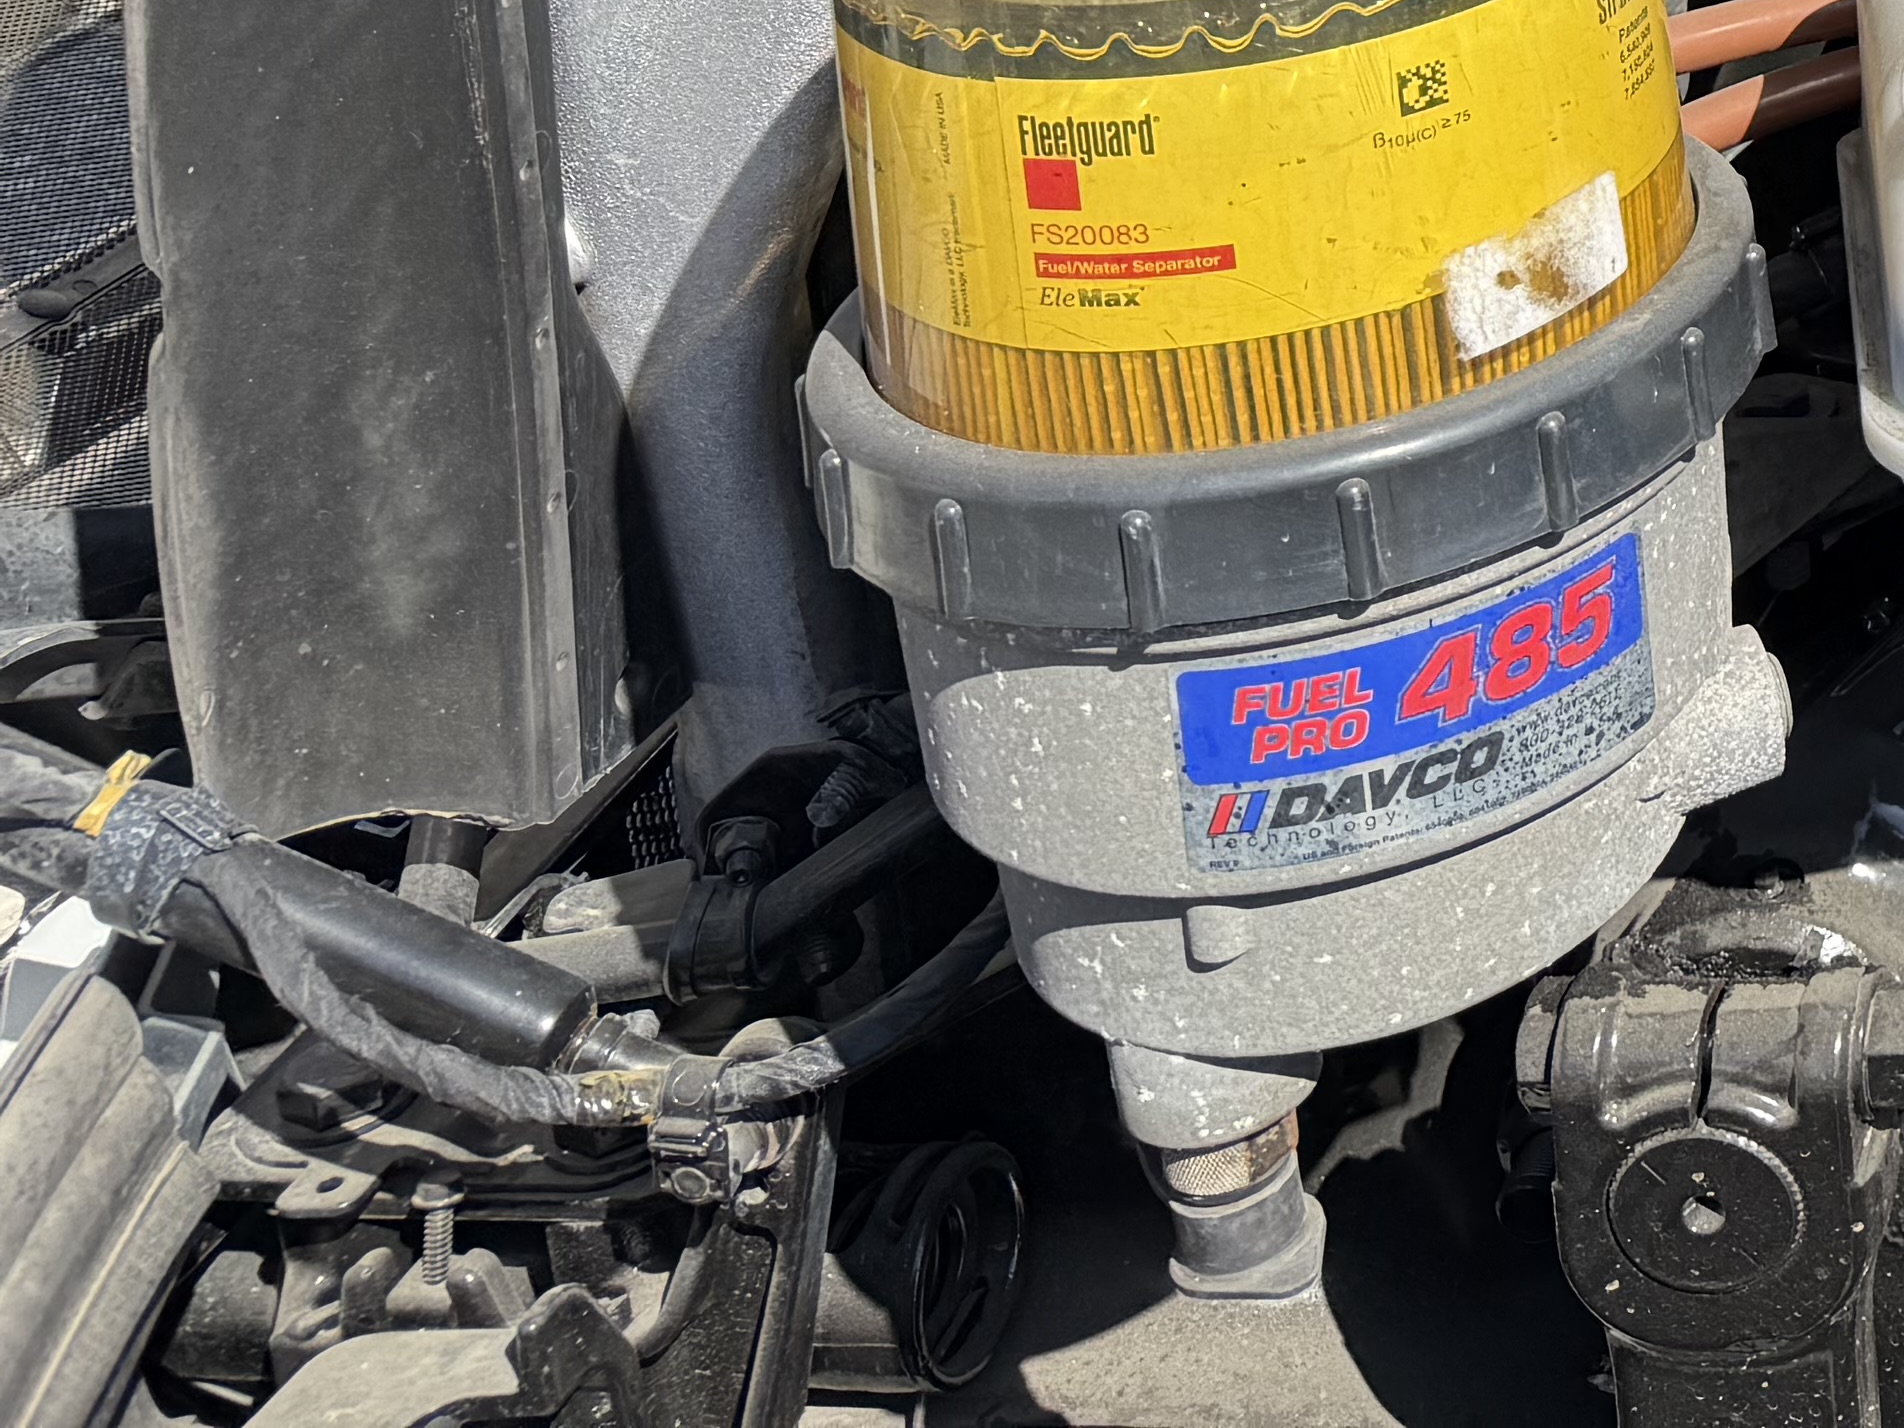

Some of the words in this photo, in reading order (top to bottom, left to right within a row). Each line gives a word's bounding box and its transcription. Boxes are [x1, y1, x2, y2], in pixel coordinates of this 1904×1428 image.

[1017, 113, 1156, 167] Fleetguard
[1031, 223, 1150, 246] FS20083
[1038, 259, 1129, 276] Fuel/Water
[1132, 255, 1222, 275] Separator
[1396, 555, 1616, 727] 485
[1232, 667, 1374, 725] FUEL
[1251, 708, 1370, 765] PRO
[1268, 731, 1505, 829] DAVCO
[1303, 851, 1318, 862] US
